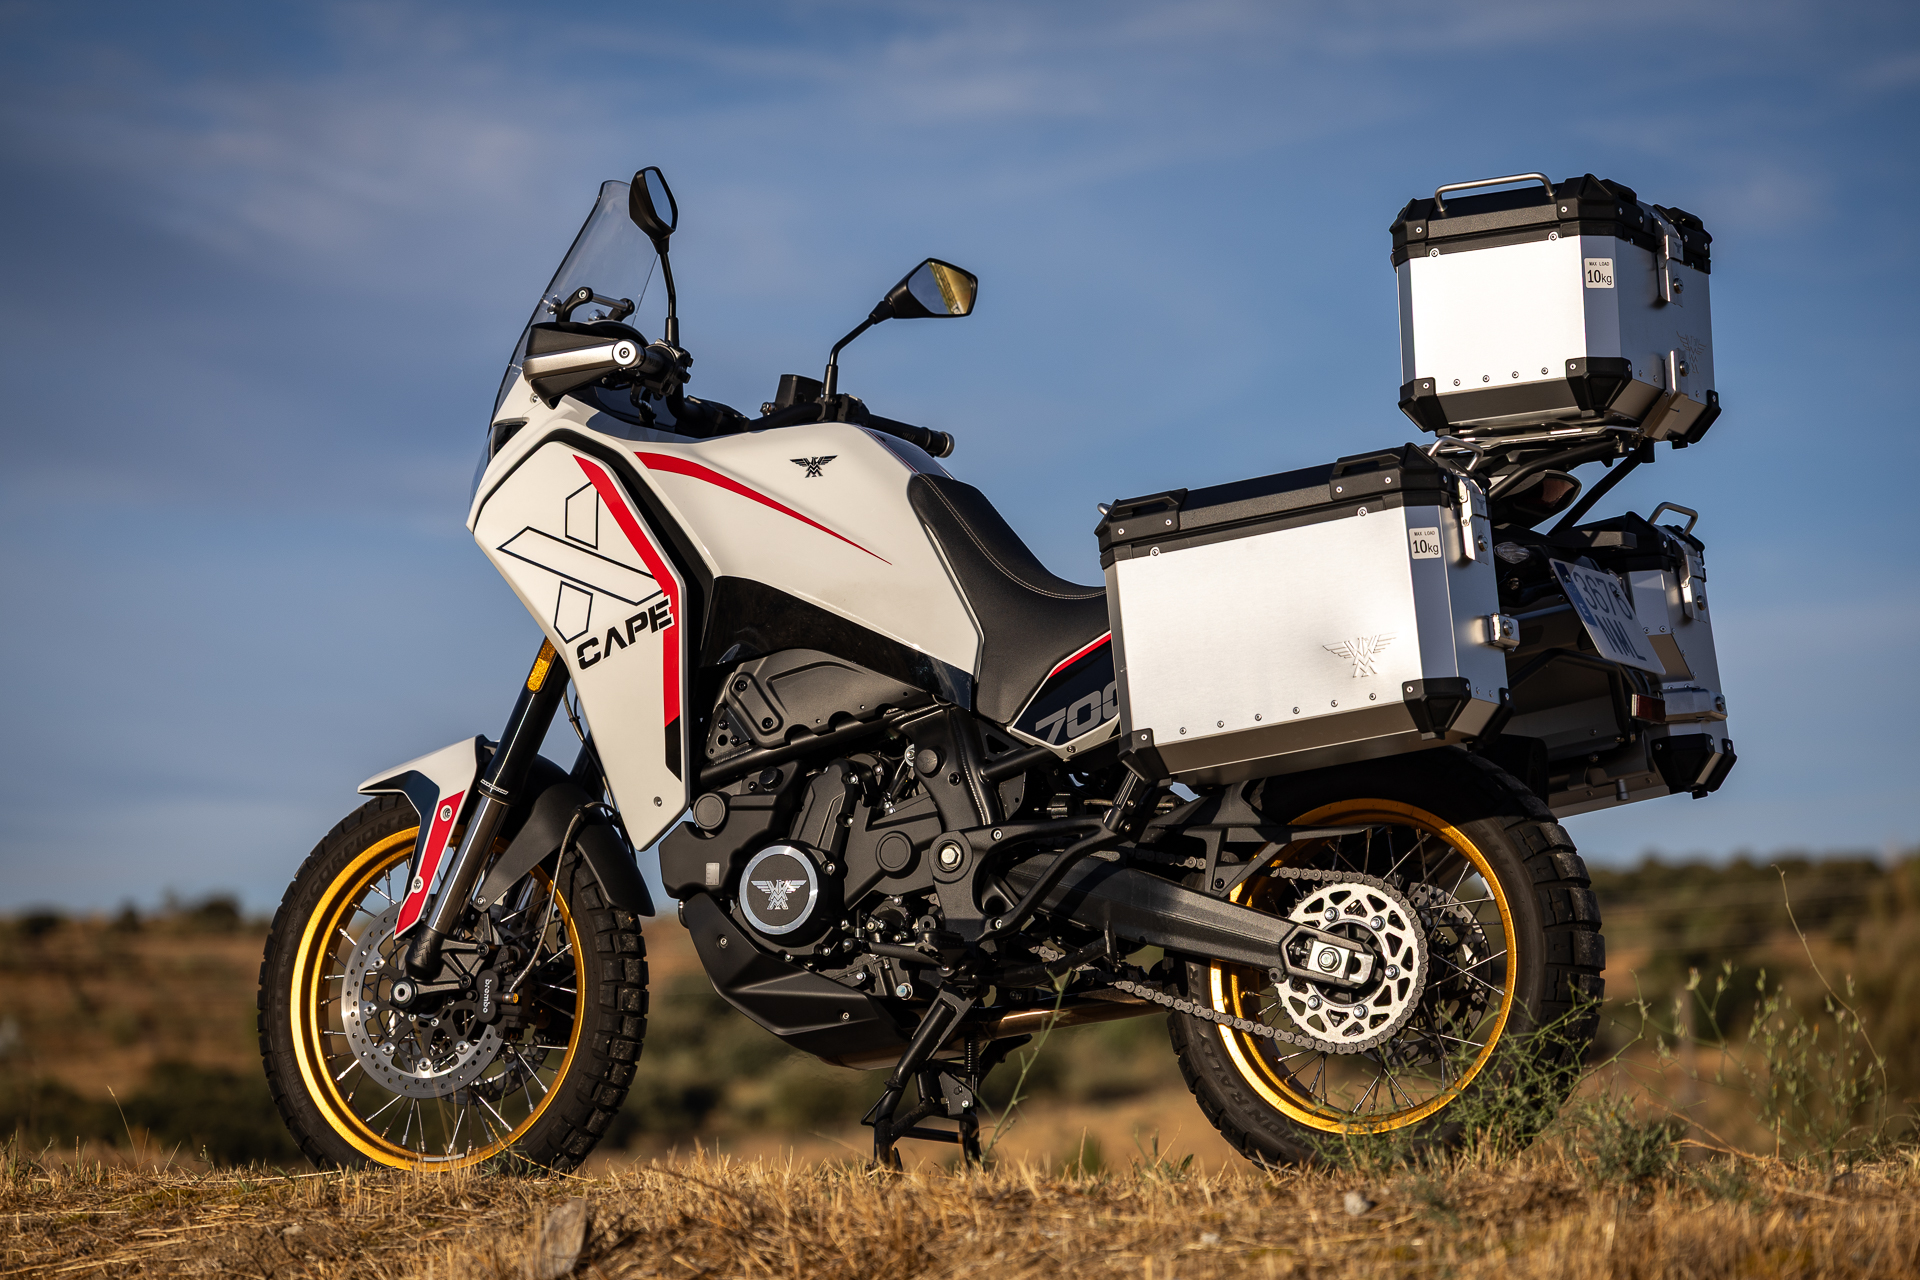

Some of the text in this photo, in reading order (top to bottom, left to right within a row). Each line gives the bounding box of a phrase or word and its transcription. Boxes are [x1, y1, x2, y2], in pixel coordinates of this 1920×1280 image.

[1587, 269, 1612, 286] 10kg
[1412, 539, 1440, 556] 10kg
[576, 597, 673, 671] CAPE
[1594, 614, 1648, 662] NML
[299, 818, 394, 914] SCORPION
[482, 978, 493, 1014] brembo
[1187, 966, 1201, 1000] TR
[1195, 1026, 1250, 1106] RALLY
